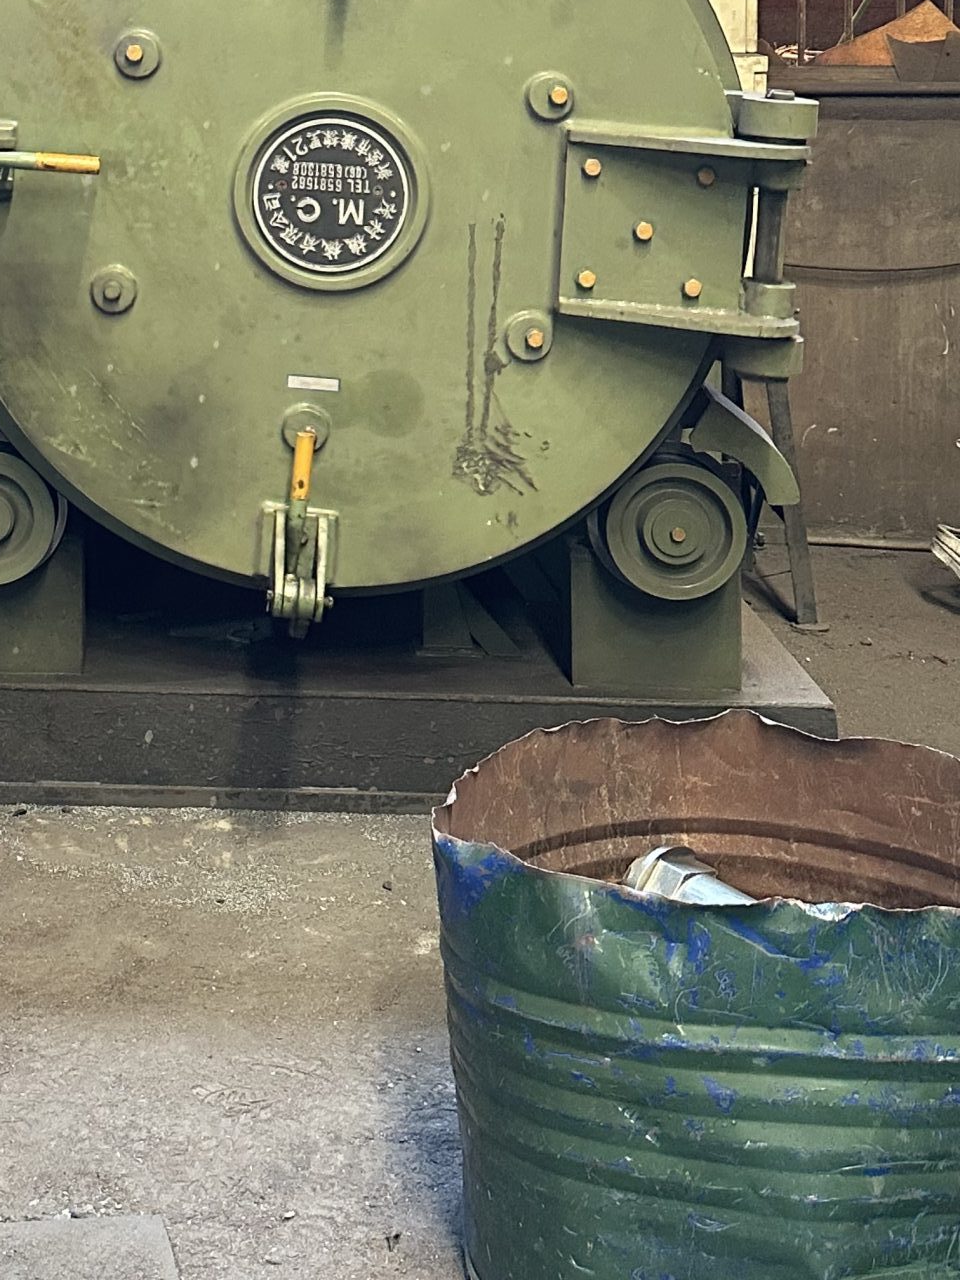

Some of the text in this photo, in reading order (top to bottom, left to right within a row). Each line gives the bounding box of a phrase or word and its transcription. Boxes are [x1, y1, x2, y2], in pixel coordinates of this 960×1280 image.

[347, 178, 371, 194] TEL
[290, 195, 365, 226] M. C.
